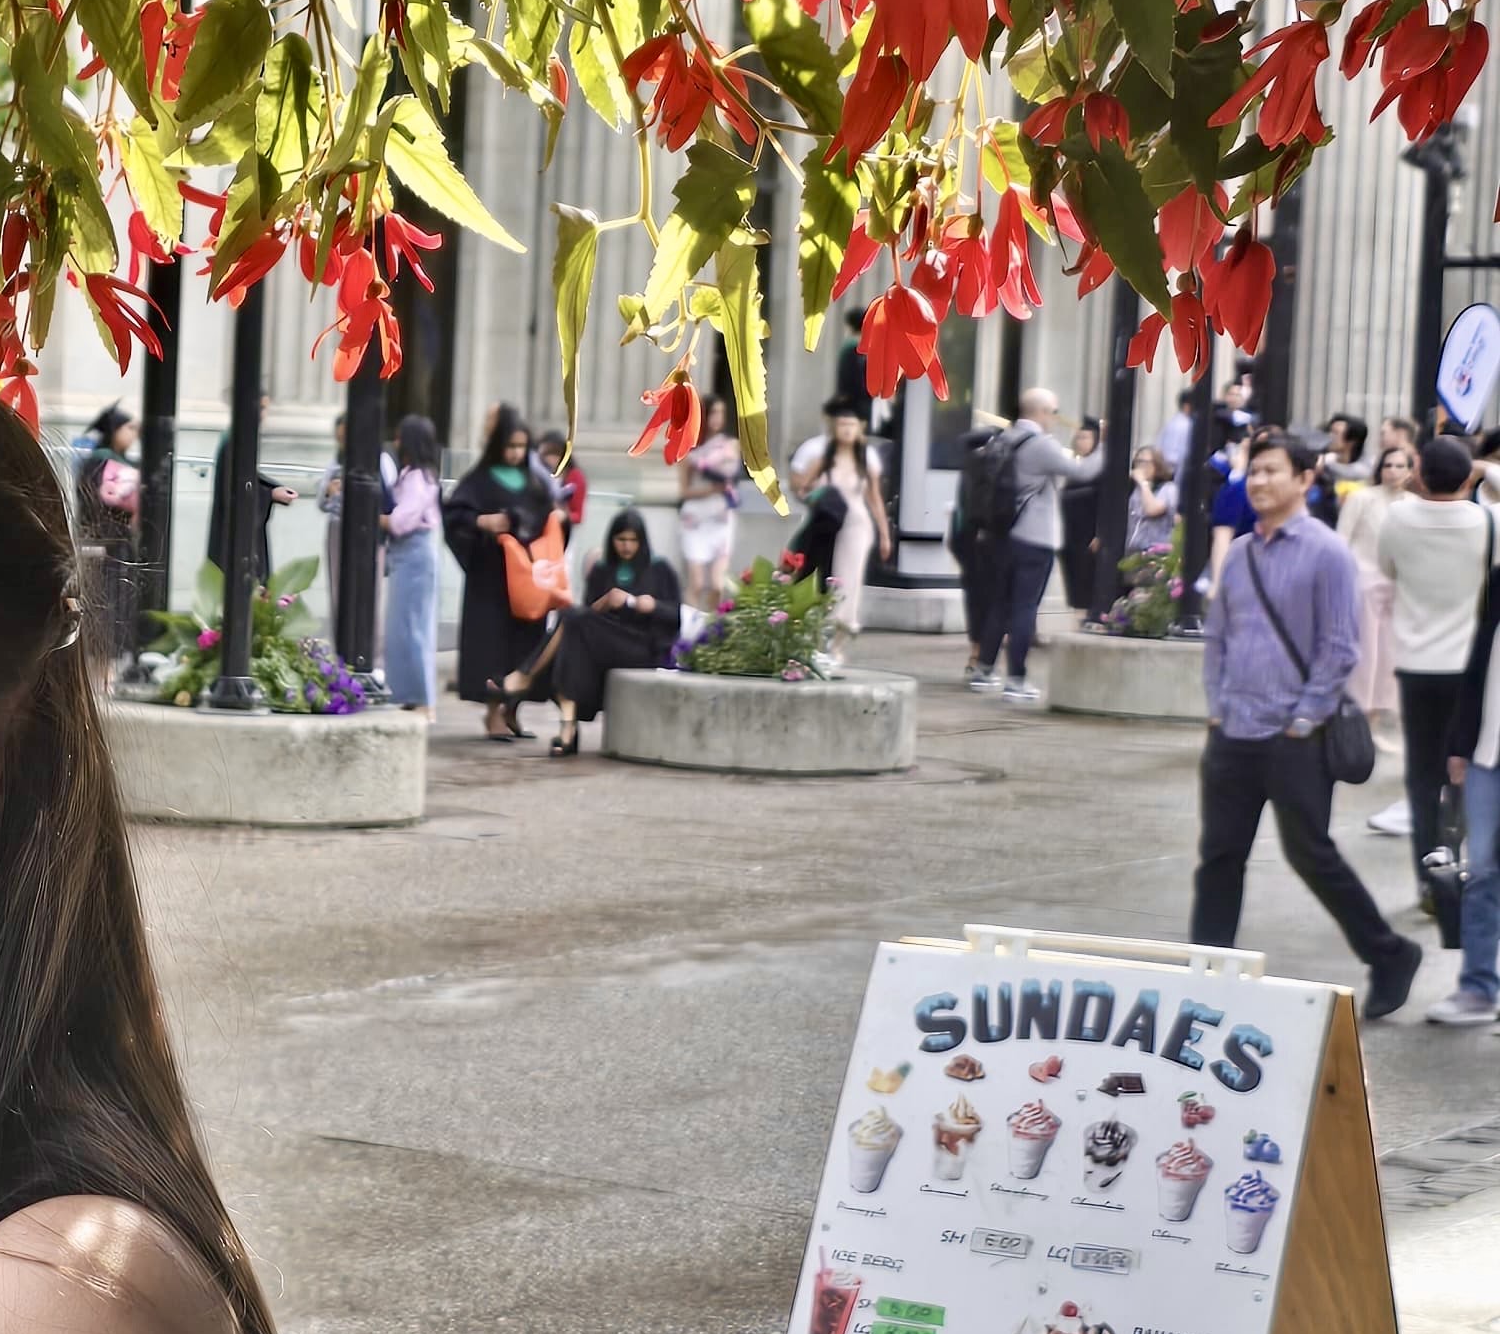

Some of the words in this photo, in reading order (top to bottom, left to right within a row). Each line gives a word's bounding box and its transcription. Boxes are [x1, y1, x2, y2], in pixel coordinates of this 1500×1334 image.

[914, 979, 1273, 1093] SUNDAES
[832, 1249, 857, 1263] ICE
[1047, 1245, 1070, 1263] LG
